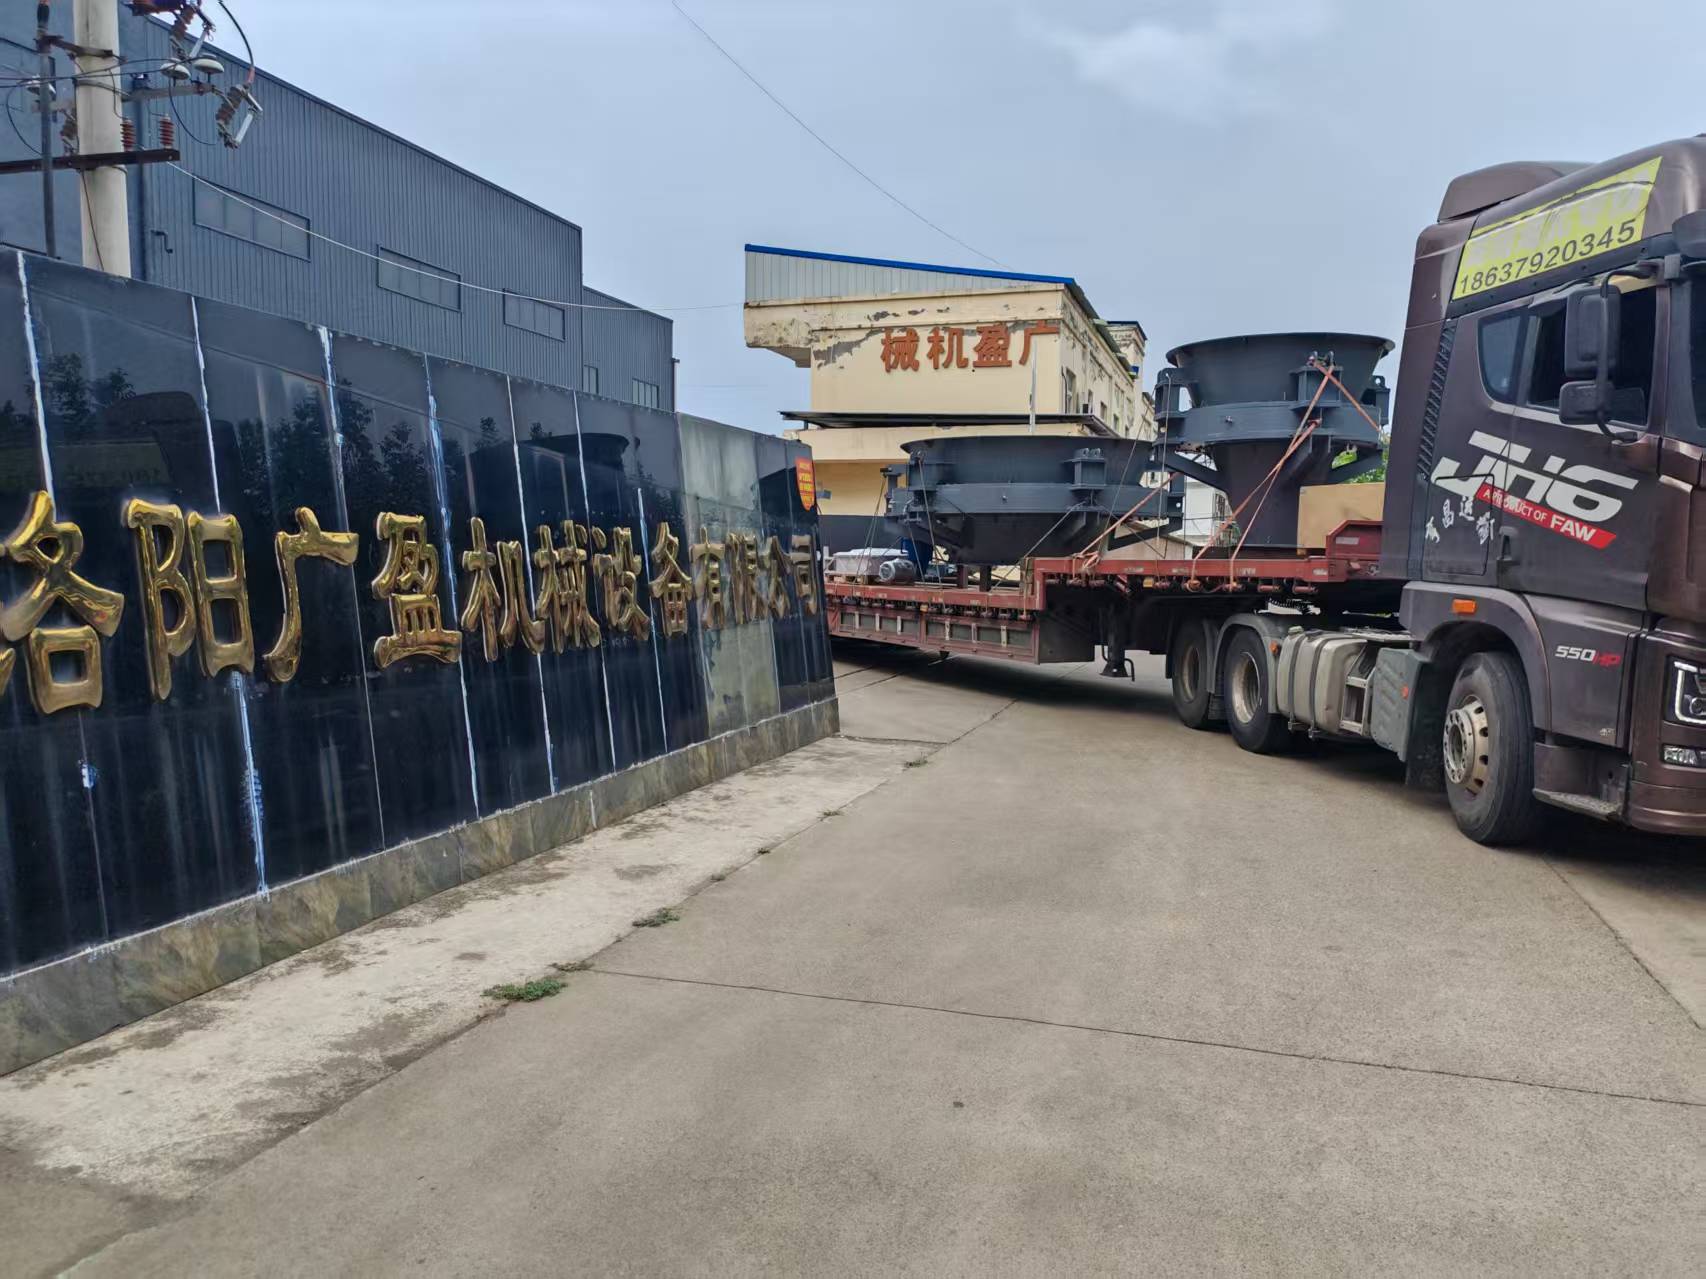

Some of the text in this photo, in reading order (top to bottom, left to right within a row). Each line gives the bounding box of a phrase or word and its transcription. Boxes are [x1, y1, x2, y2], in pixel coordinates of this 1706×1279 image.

[1460, 218, 1637, 294] 18637920345
[1533, 508, 1547, 522] OF
[1550, 514, 1597, 542] FAW
